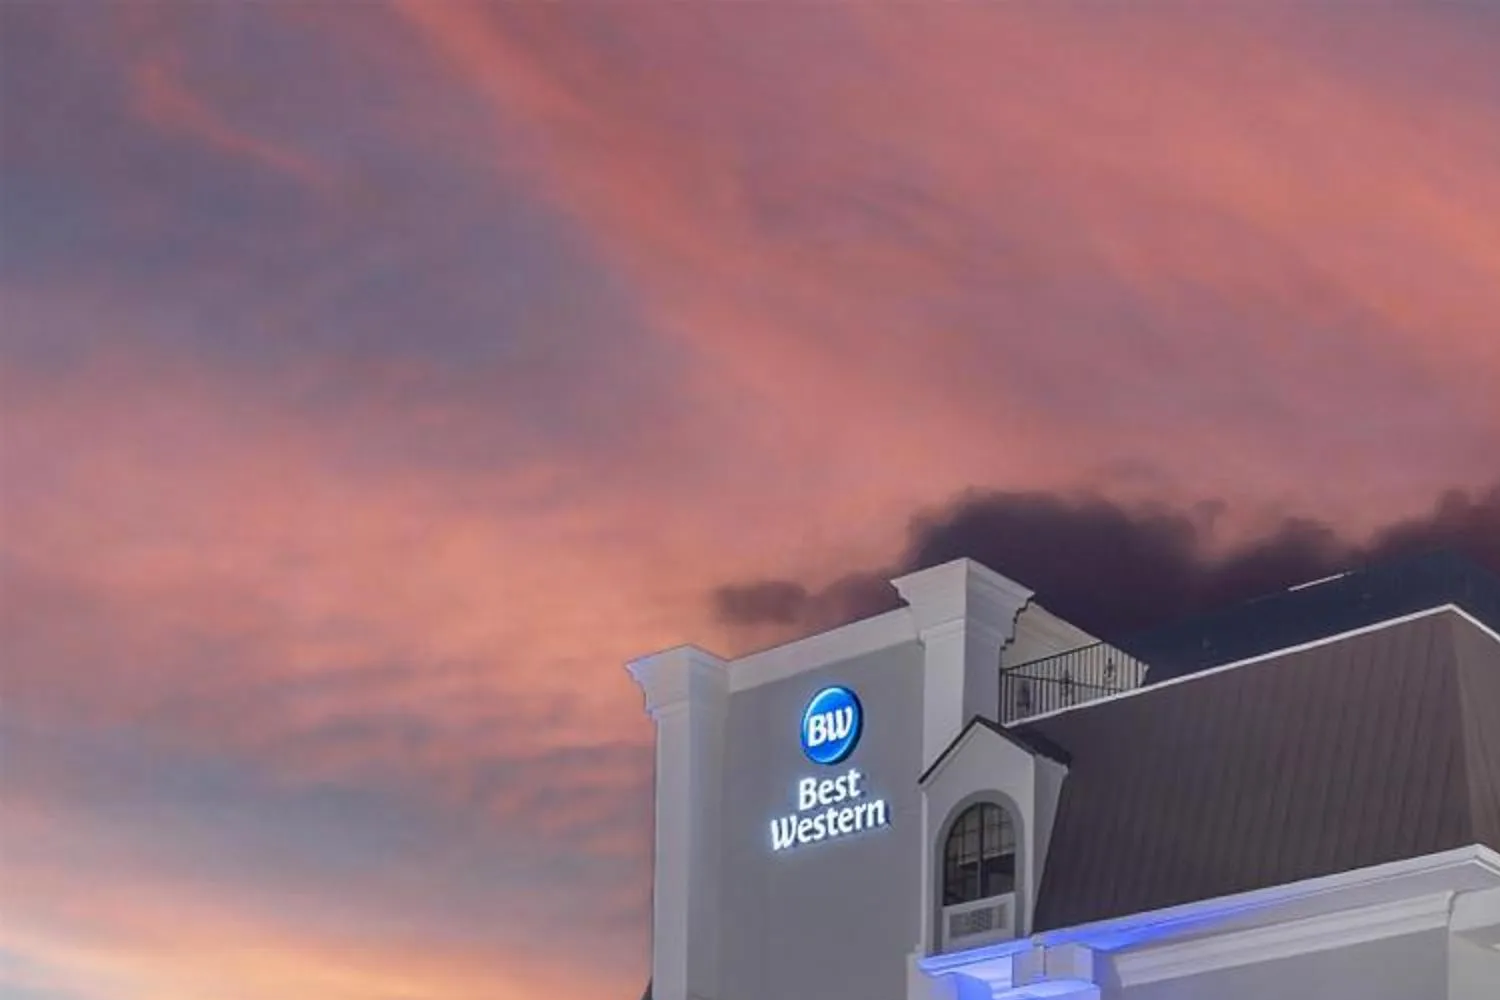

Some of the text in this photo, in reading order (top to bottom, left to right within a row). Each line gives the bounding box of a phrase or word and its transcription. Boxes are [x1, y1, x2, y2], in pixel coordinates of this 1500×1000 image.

[808, 705, 854, 747] BW
[799, 768, 861, 811] Best
[770, 799, 886, 851] Western
